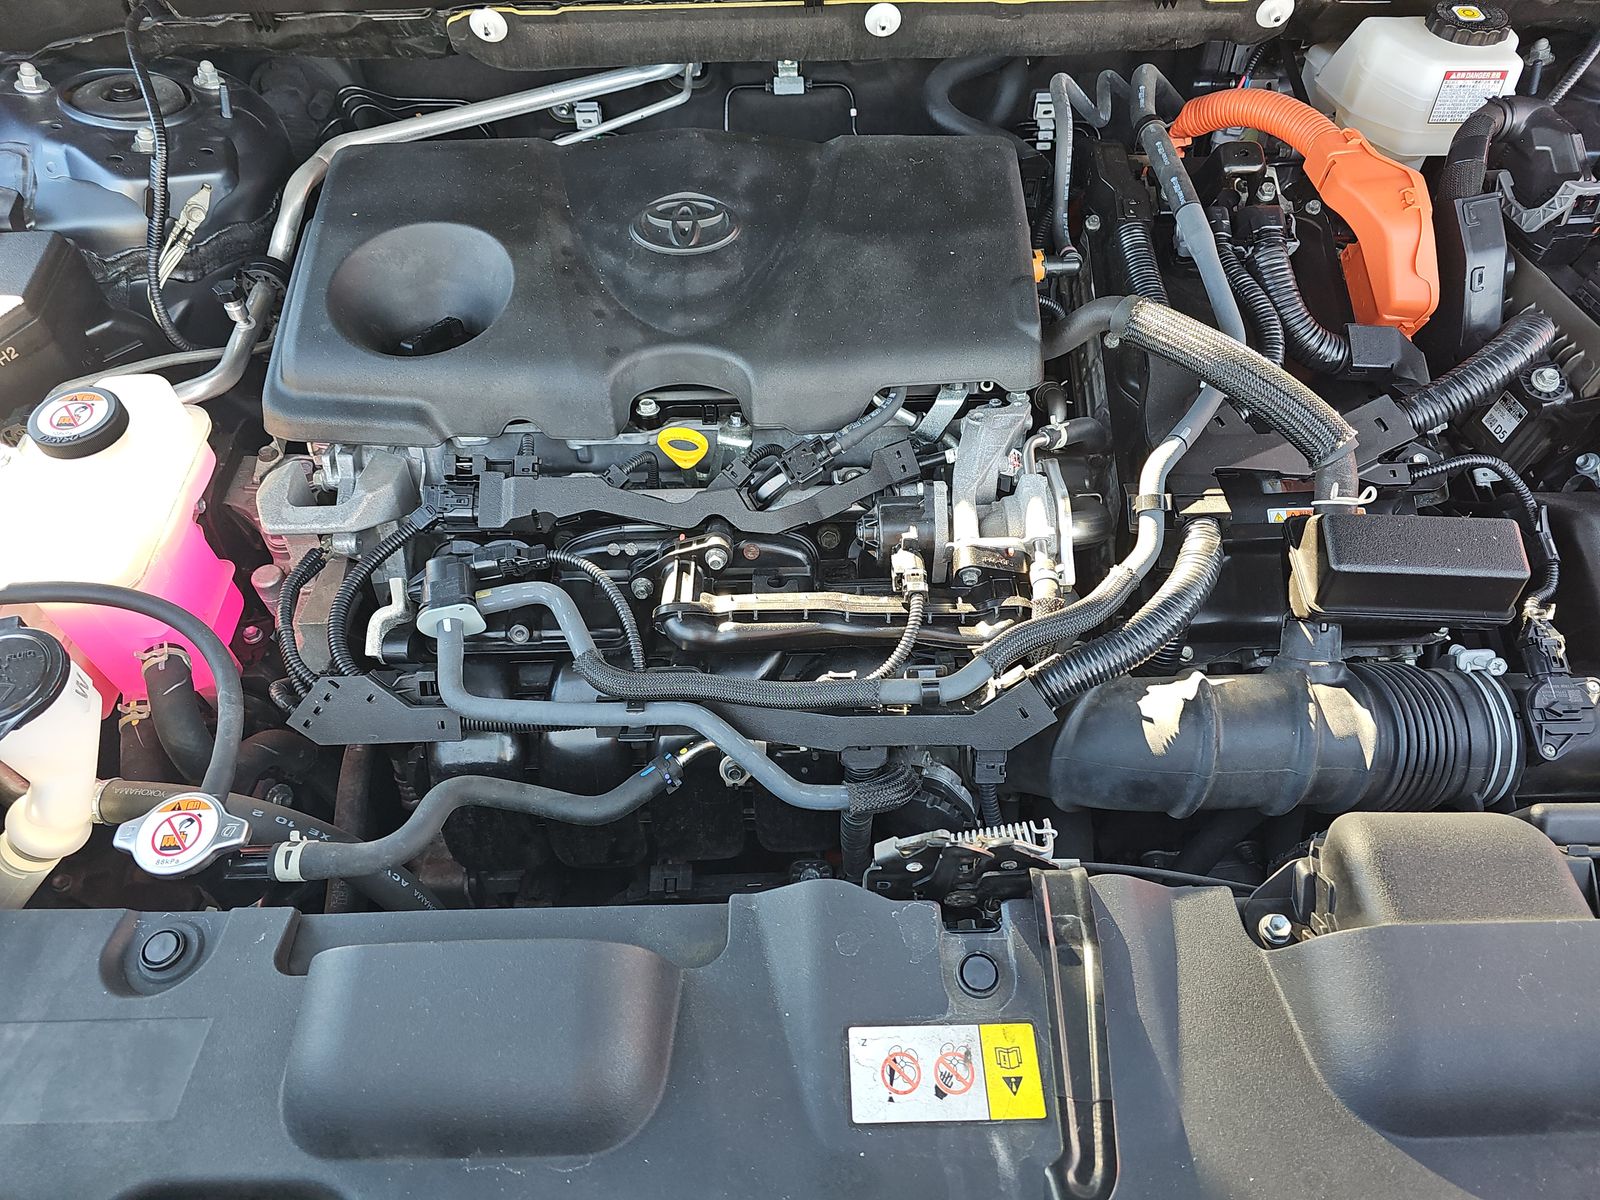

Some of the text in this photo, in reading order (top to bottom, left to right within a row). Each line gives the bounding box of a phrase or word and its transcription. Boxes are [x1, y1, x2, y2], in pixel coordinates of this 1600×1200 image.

[1493, 423, 1508, 440] D5
[40, 433, 81, 444] DENSO
[114, 786, 166, 798] YOKOHAMA
[251, 808, 332, 842] XE 10 2
[155, 858, 180, 866] 88kPa
[860, 1038, 868, 1047] Z
